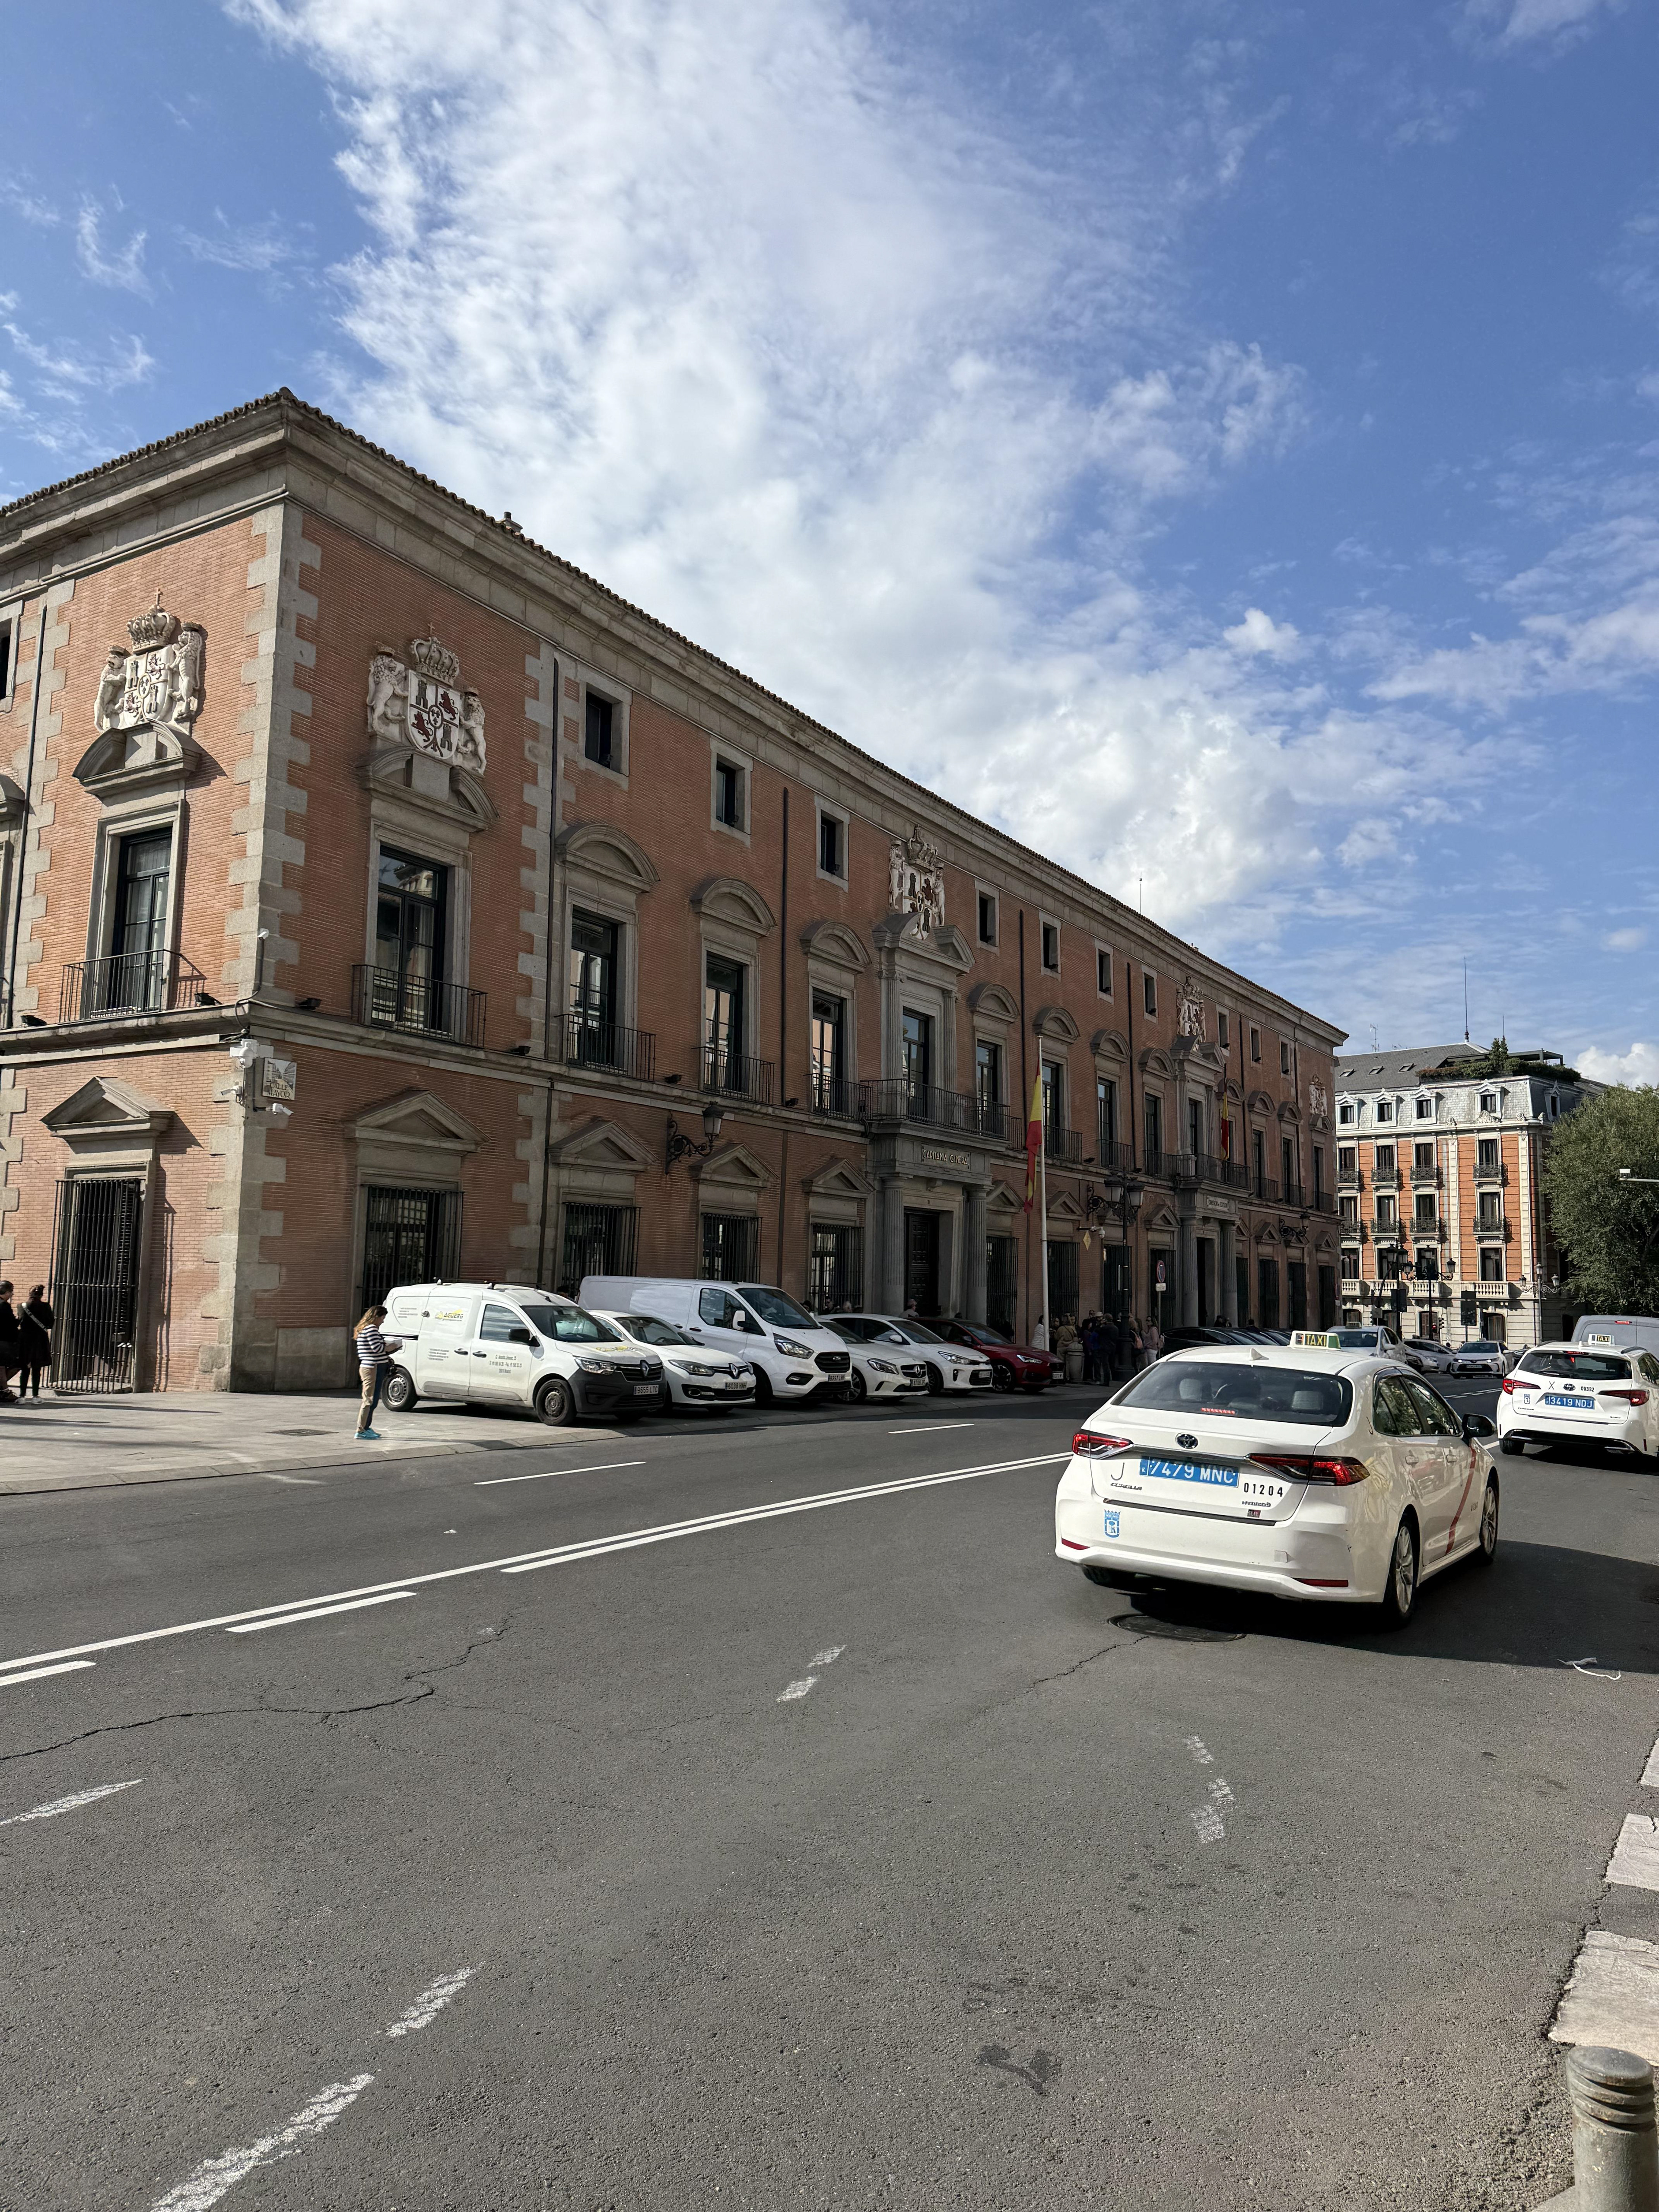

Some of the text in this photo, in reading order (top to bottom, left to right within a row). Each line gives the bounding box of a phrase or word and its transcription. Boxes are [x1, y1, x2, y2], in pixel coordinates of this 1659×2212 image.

[270, 1082, 289, 1091] CALLE
[267, 1089, 291, 1100] MAYOR
[1306, 1335, 1326, 1346] TAXI
[1551, 1396, 1592, 1408] 3419 NDJ
[1111, 1462, 1125, 1481] J
[1150, 1458, 1233, 1483] 7479 MNC
[1244, 1482, 1283, 1497] 01204
